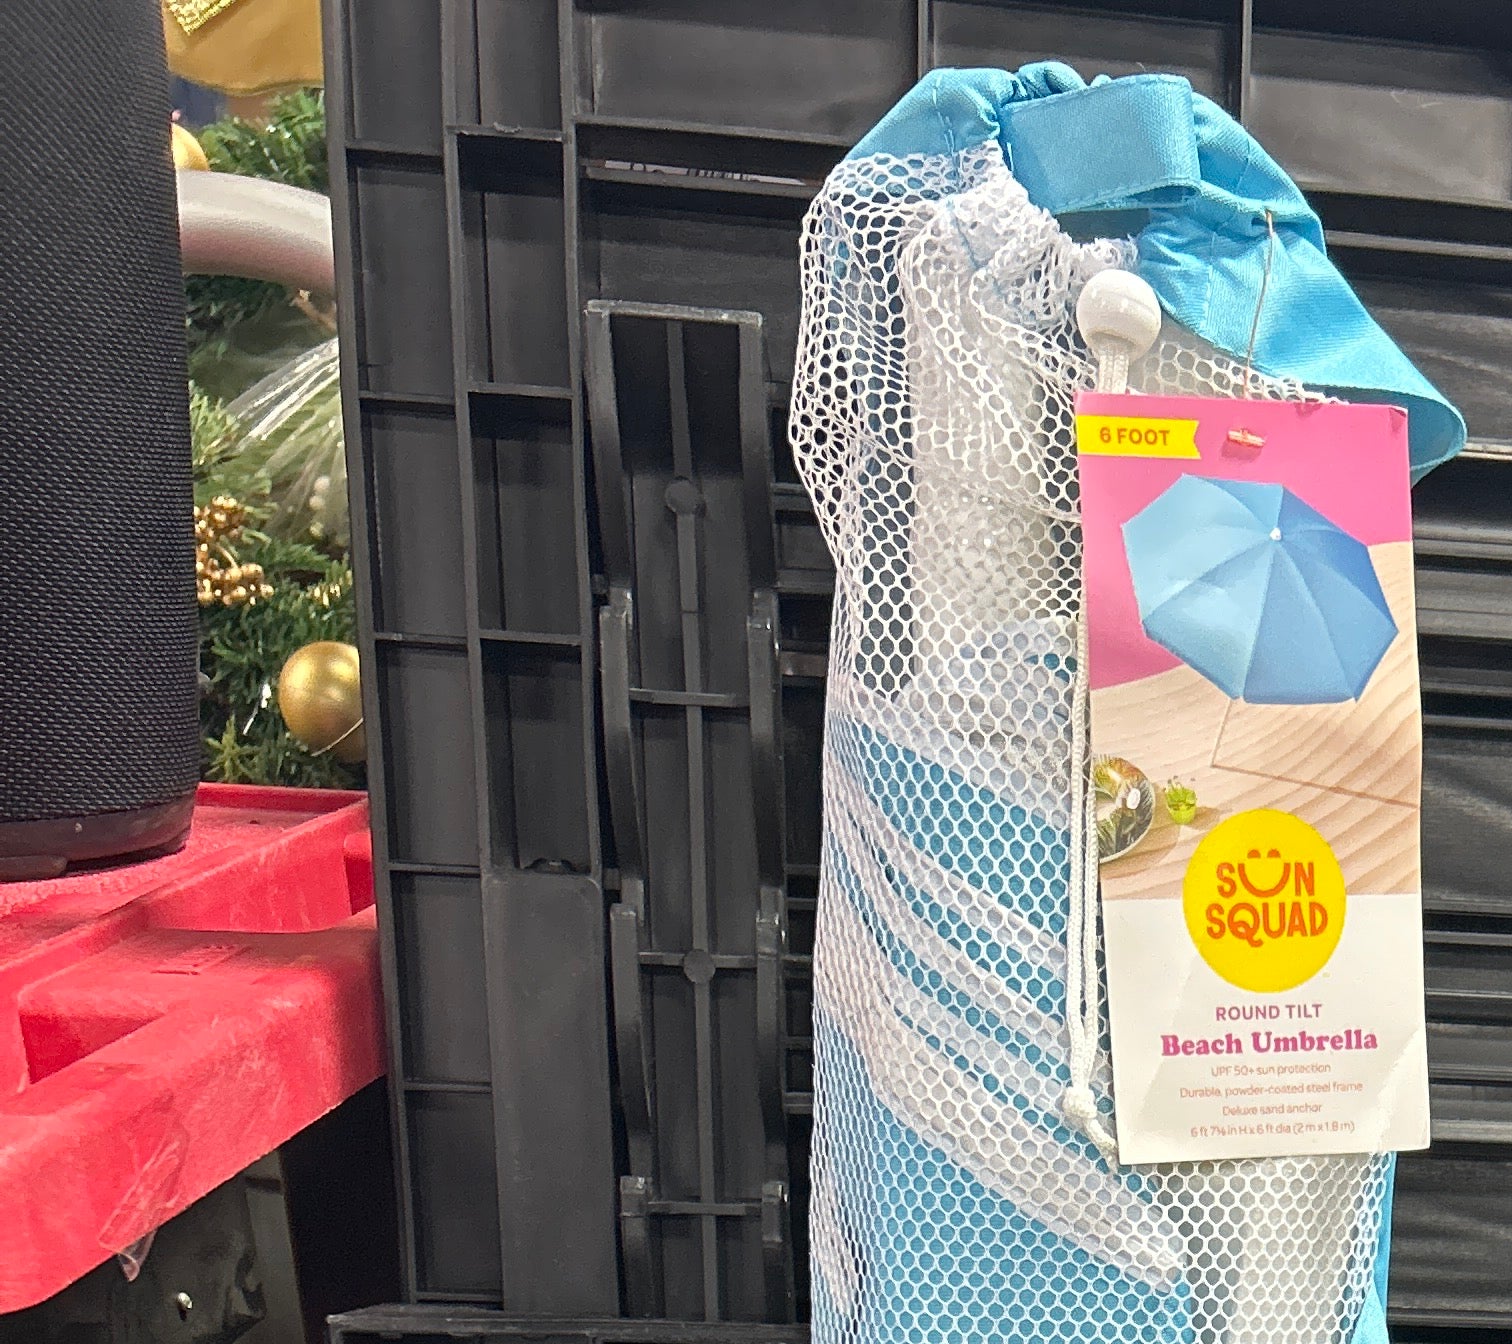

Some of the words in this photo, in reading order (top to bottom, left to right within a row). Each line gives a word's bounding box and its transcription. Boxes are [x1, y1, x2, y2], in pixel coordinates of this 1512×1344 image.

[1099, 426, 1112, 444] 6
[1116, 427, 1170, 446] FOOT
[1216, 855, 1315, 899] SUN
[1205, 901, 1329, 948] SQUAD
[1215, 1004, 1281, 1022] ROUND
[1284, 1003, 1323, 1020] TILT
[1160, 1032, 1243, 1057] Beach
[1251, 1028, 1378, 1054] Umbrella
[1210, 1065, 1232, 1078] UPF
[1233, 1064, 1255, 1077] 50+
[1255, 1065, 1275, 1076] sun
[1277, 1062, 1331, 1078] protection
[1225, 1083, 1305, 1099] powder-coated
[1306, 1081, 1331, 1094] steel
[1332, 1080, 1364, 1093] frame
[1222, 1105, 1258, 1117] Deluxe
[1259, 1103, 1285, 1116] sand
[1286, 1102, 1322, 1114] anchor
[1190, 1126, 1198, 1138] 6
[1199, 1125, 1208, 1138] ft
[1227, 1124, 1237, 1136] in
[1238, 1124, 1248, 1136] H
[1256, 1123, 1264, 1136] 6
[1265, 1122, 1274, 1135] ft
[1275, 1122, 1291, 1135] dia
[1292, 1121, 1304, 1135] (2
[1305, 1123, 1316, 1133] m
[1324, 1120, 1339, 1133] 1.8
[1340, 1119, 1356, 1134] m)
